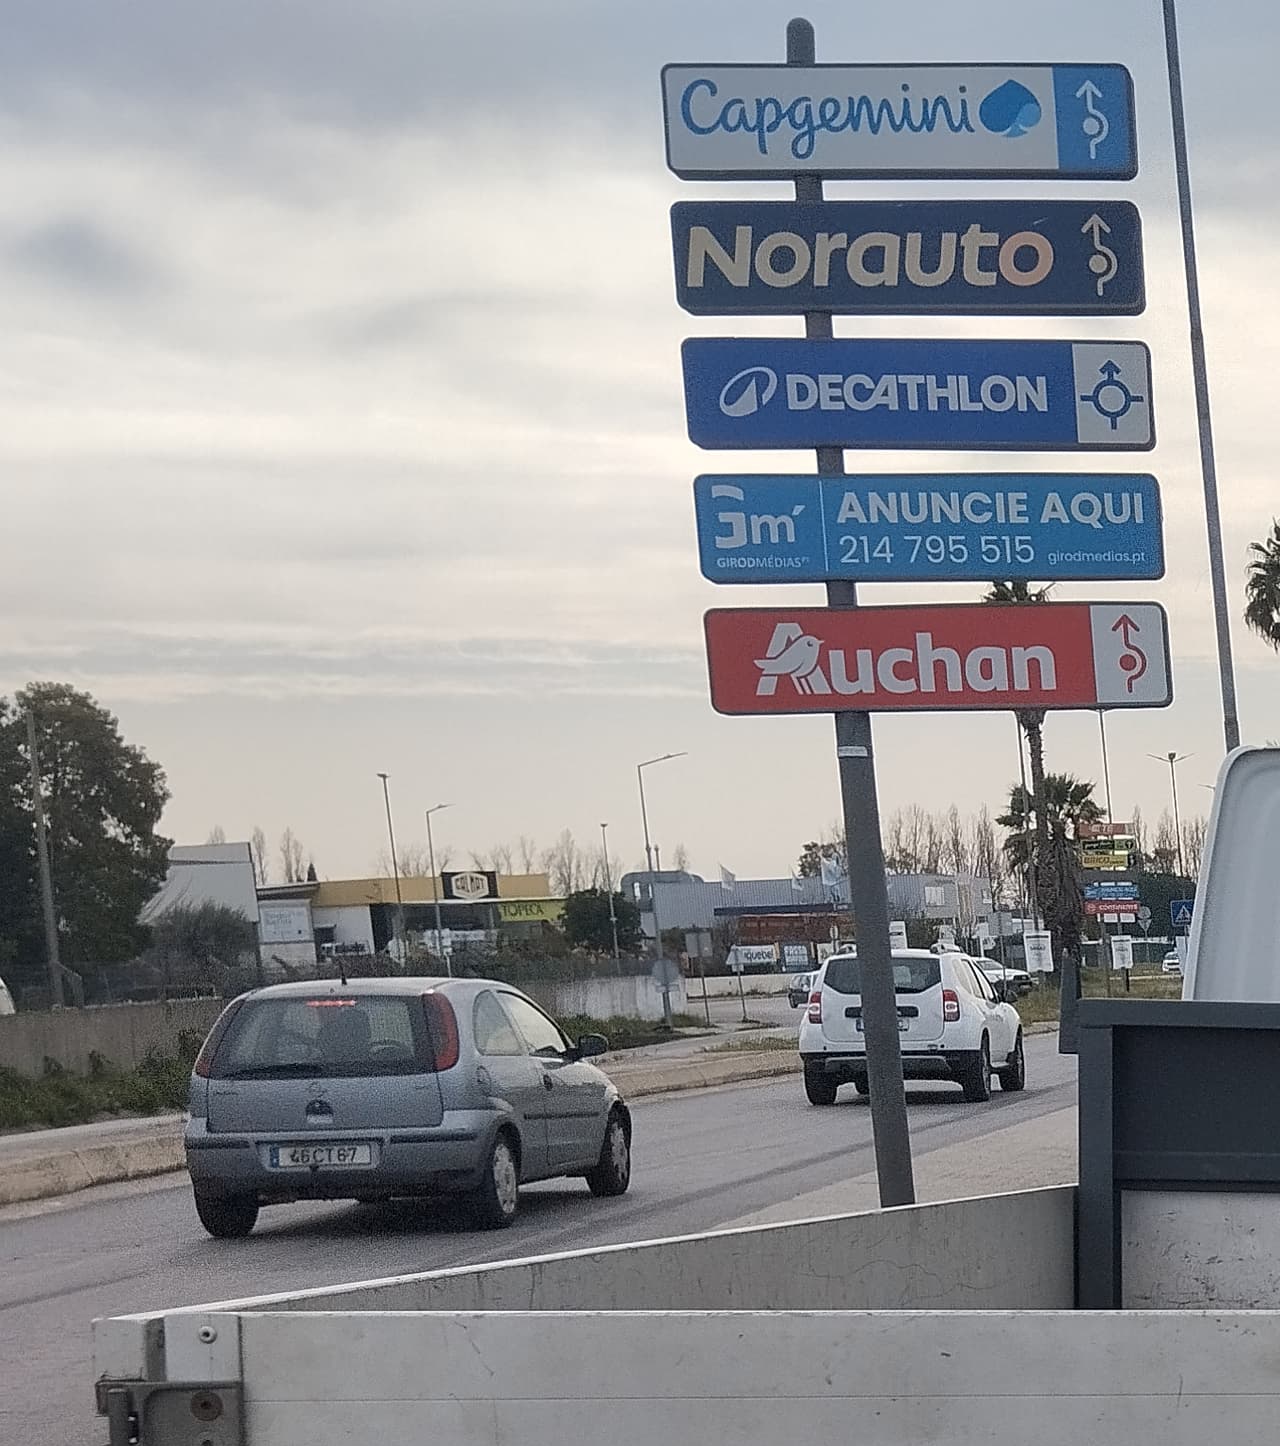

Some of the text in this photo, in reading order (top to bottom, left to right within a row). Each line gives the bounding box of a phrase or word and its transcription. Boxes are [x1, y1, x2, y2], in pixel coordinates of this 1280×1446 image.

[681, 78, 976, 160] Capgemini
[686, 223, 1055, 288] Norauto
[786, 373, 1049, 412] DECATHLON
[836, 491, 1144, 529] ANUNCIE AQUI
[839, 535, 1035, 563] 214 795 515
[1047, 549, 1146, 566] girodmedias.pt
[753, 622, 1057, 696] Auchan
